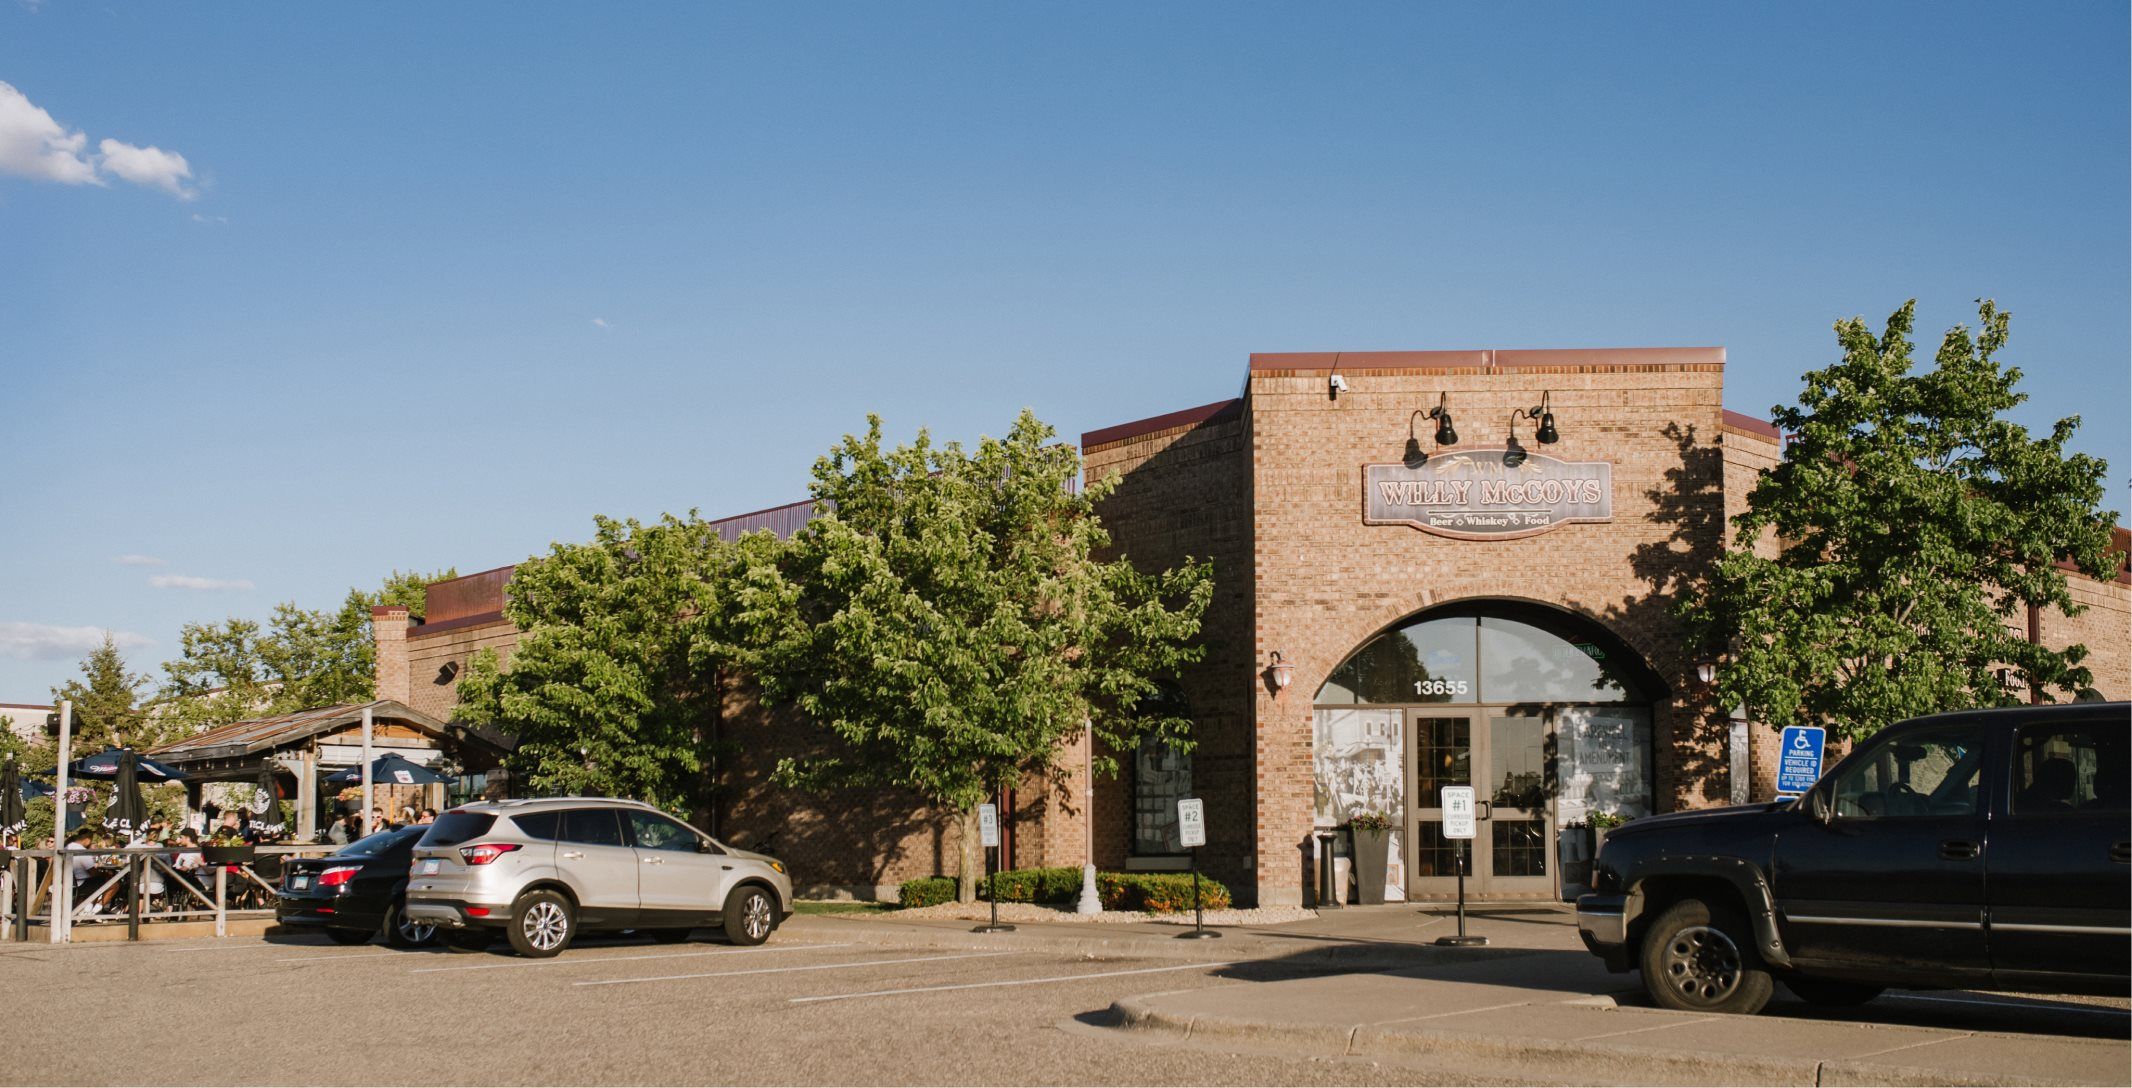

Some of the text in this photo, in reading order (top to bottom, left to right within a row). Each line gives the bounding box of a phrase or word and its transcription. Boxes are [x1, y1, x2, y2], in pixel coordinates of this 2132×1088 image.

[1378, 479, 1602, 506] WILLY McCOYS
[1429, 516, 1550, 527] Beer Whiskey Food
[1414, 680, 1468, 695] 13655
[1578, 724, 1627, 739] AREWELL
[1785, 759, 1809, 767] VEHICLE
[1452, 800, 1466, 811] #1
[984, 814, 993, 824] #3
[1185, 811, 1198, 822] #2
